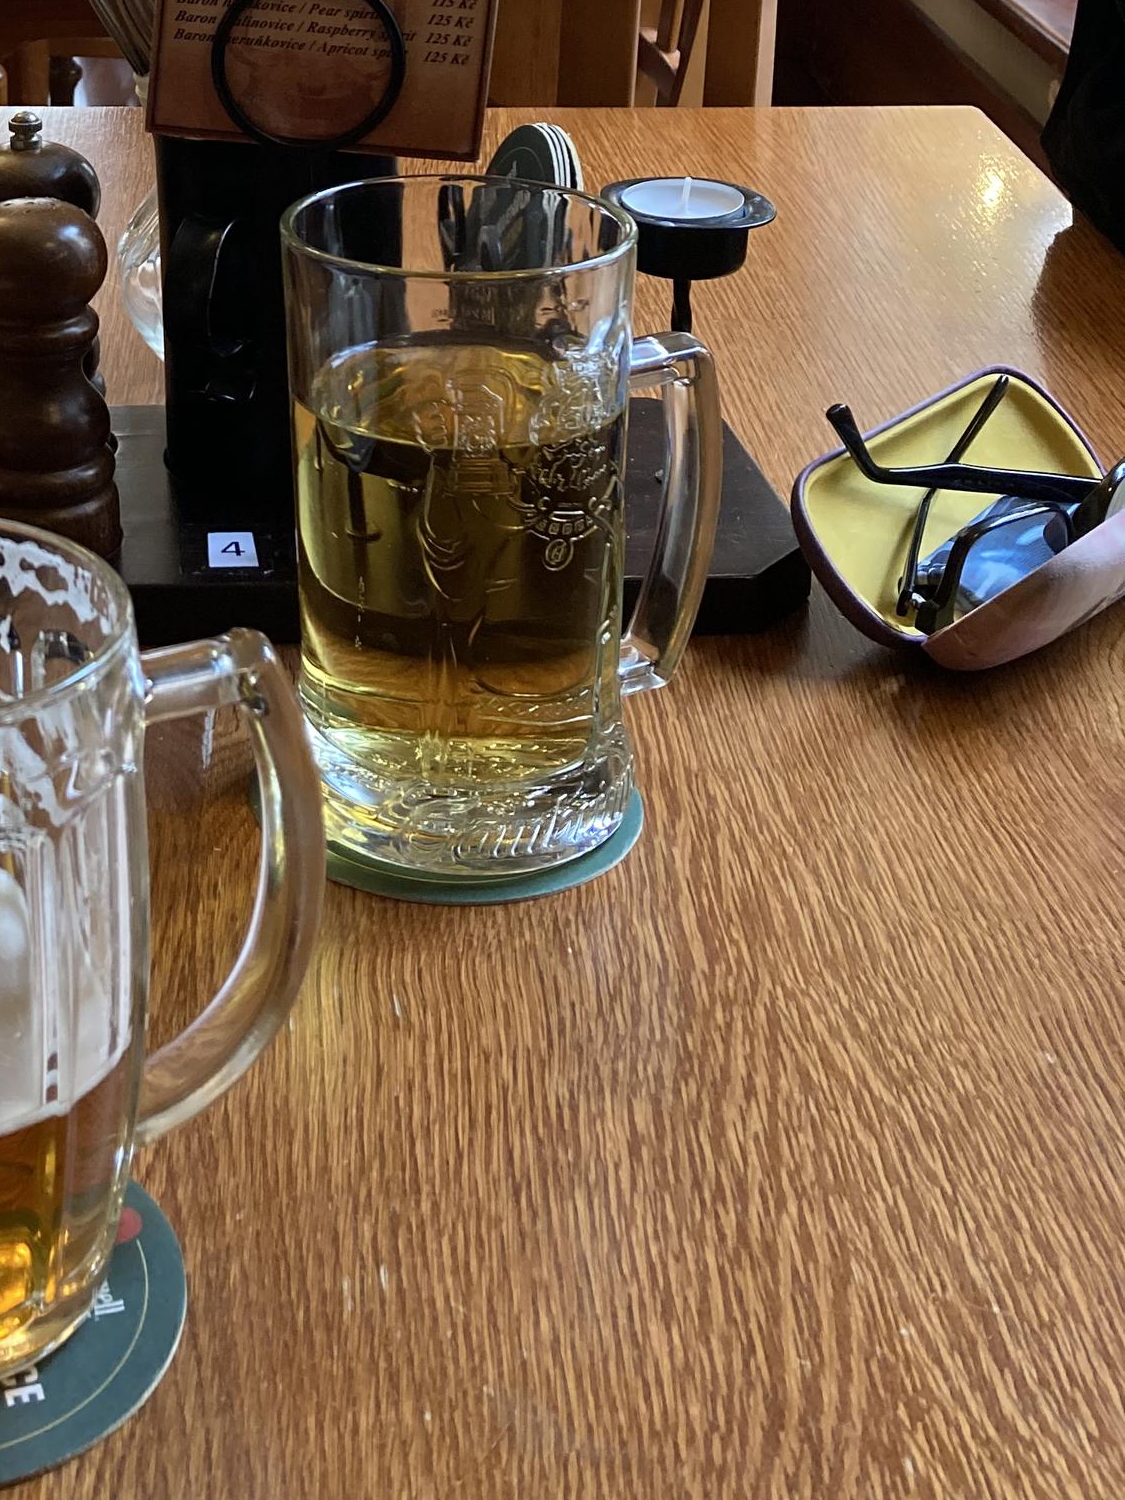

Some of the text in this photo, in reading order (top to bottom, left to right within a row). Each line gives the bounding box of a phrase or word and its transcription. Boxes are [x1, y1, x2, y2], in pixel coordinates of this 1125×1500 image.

[175, 10, 217, 24] Baron
[307, 21, 376, 41] Raspberry
[425, 33, 449, 45] 125
[453, 34, 474, 48] Kč
[308, 3, 343, 17] Pear
[427, 14, 451, 27] 125
[454, 16, 475, 29] Kč
[173, 28, 216, 43] Baron
[317, 41, 369, 57] Apricot
[423, 51, 447, 63] 125
[450, 53, 471, 66] Kč
[221, 541, 246, 557] 4
